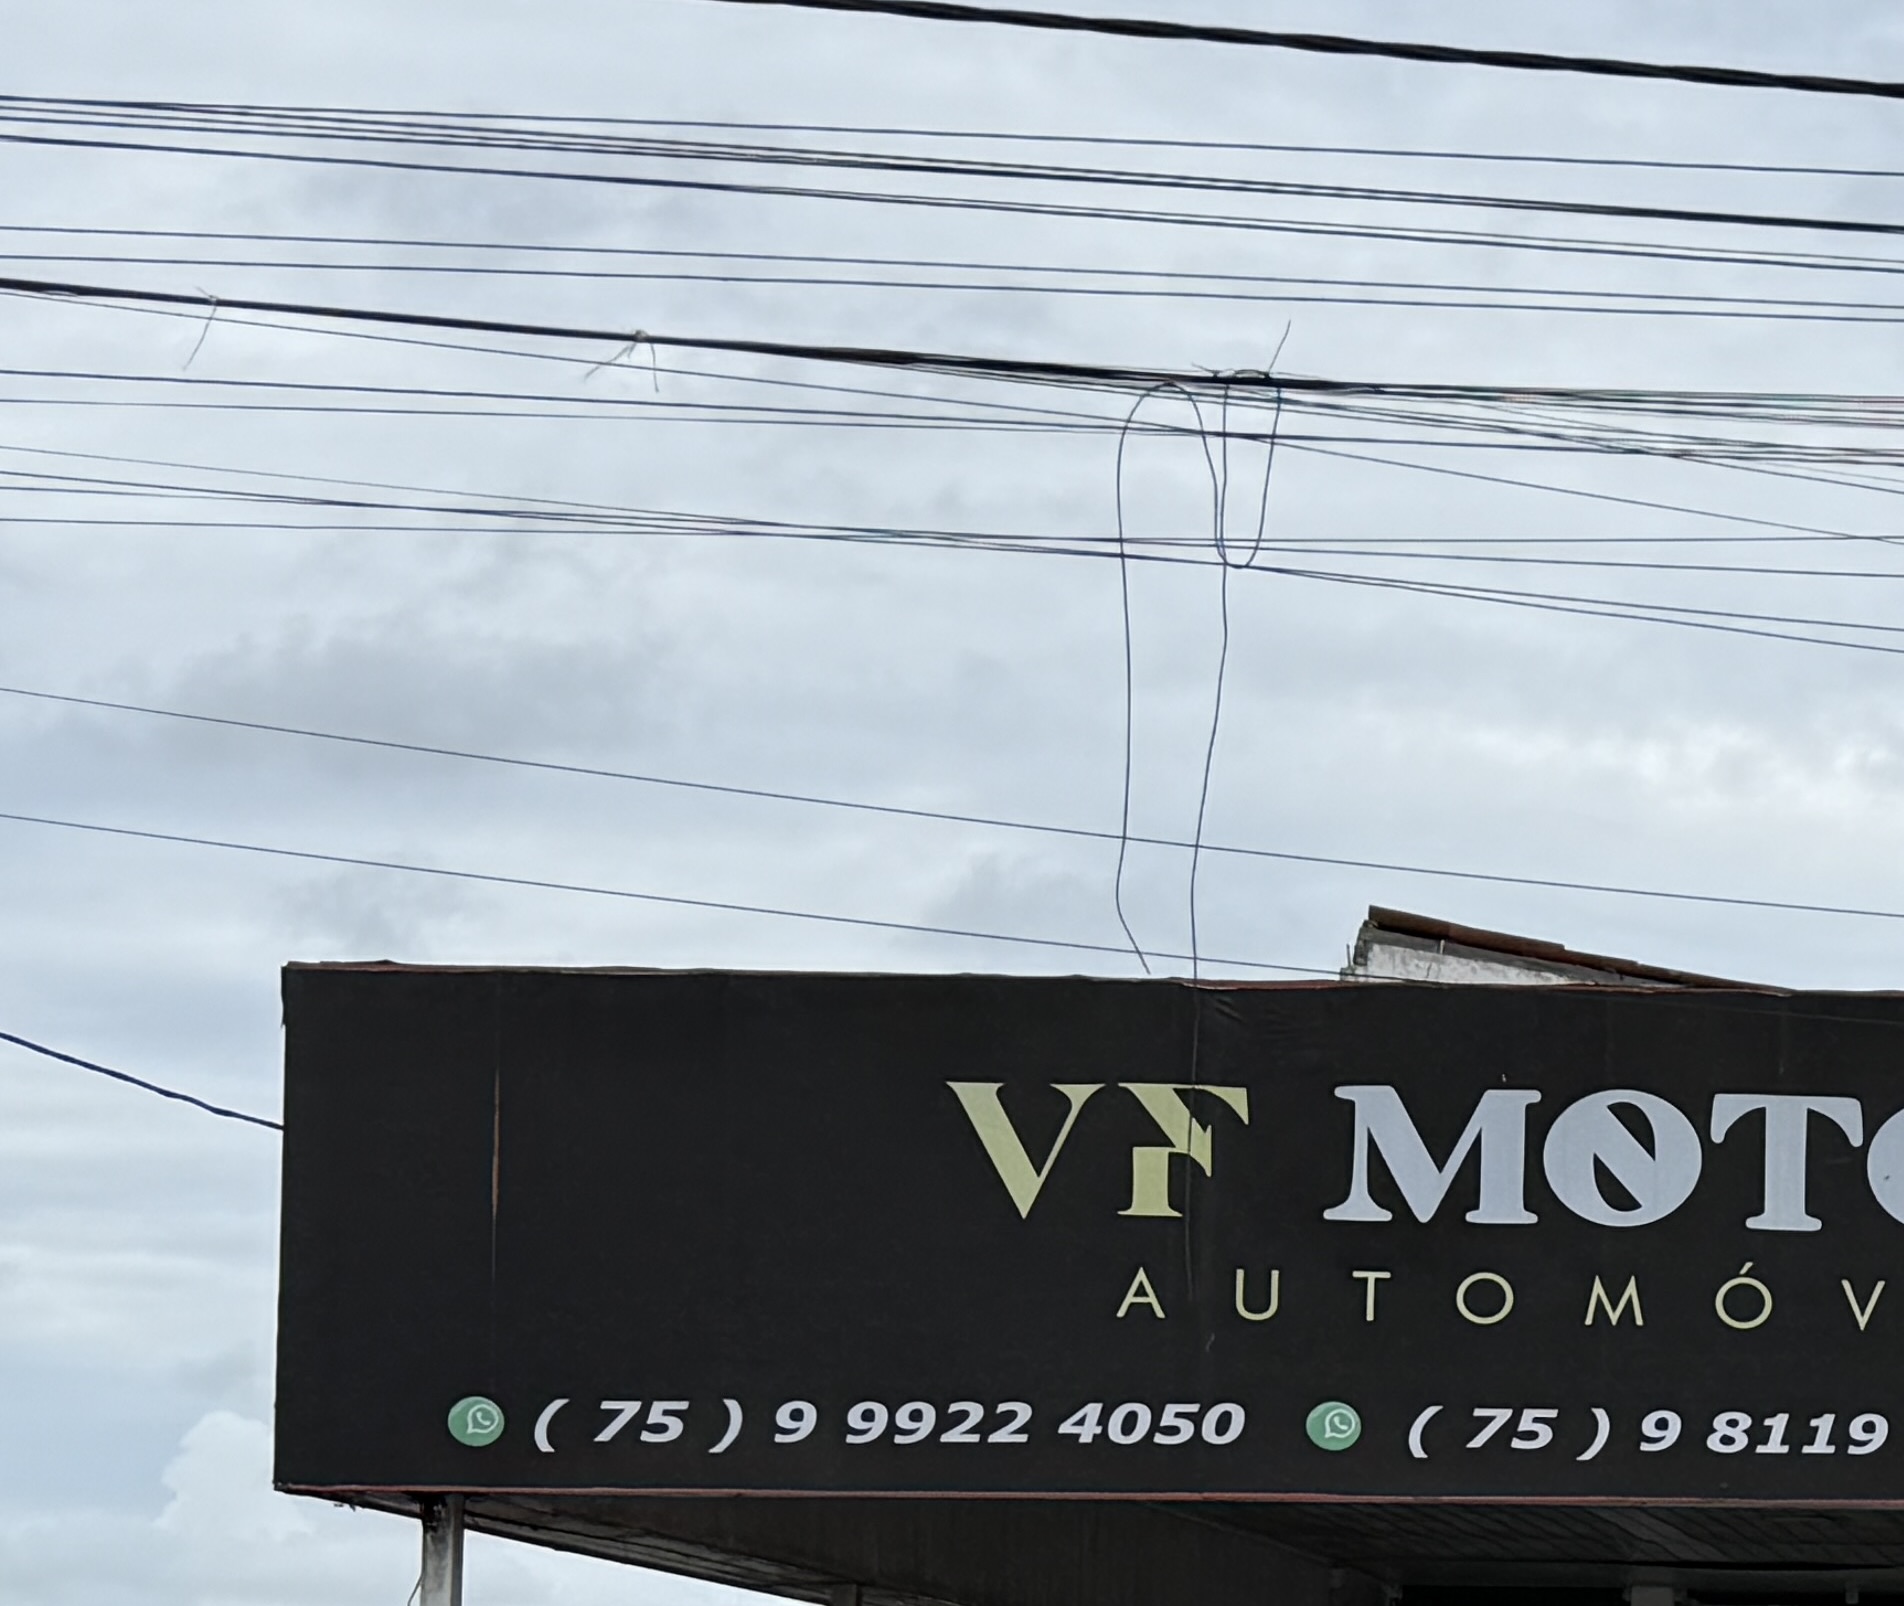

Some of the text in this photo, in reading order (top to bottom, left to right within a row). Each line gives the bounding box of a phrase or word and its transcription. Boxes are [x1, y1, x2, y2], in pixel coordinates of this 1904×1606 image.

[947, 1082, 1250, 1219] VF
[774, 1400, 818, 1443] 9
[845, 1401, 1033, 1445] 9922
[1057, 1402, 1246, 1445] 4050
[1639, 1410, 1682, 1452] 9
[1706, 1411, 1889, 1455] 8119
